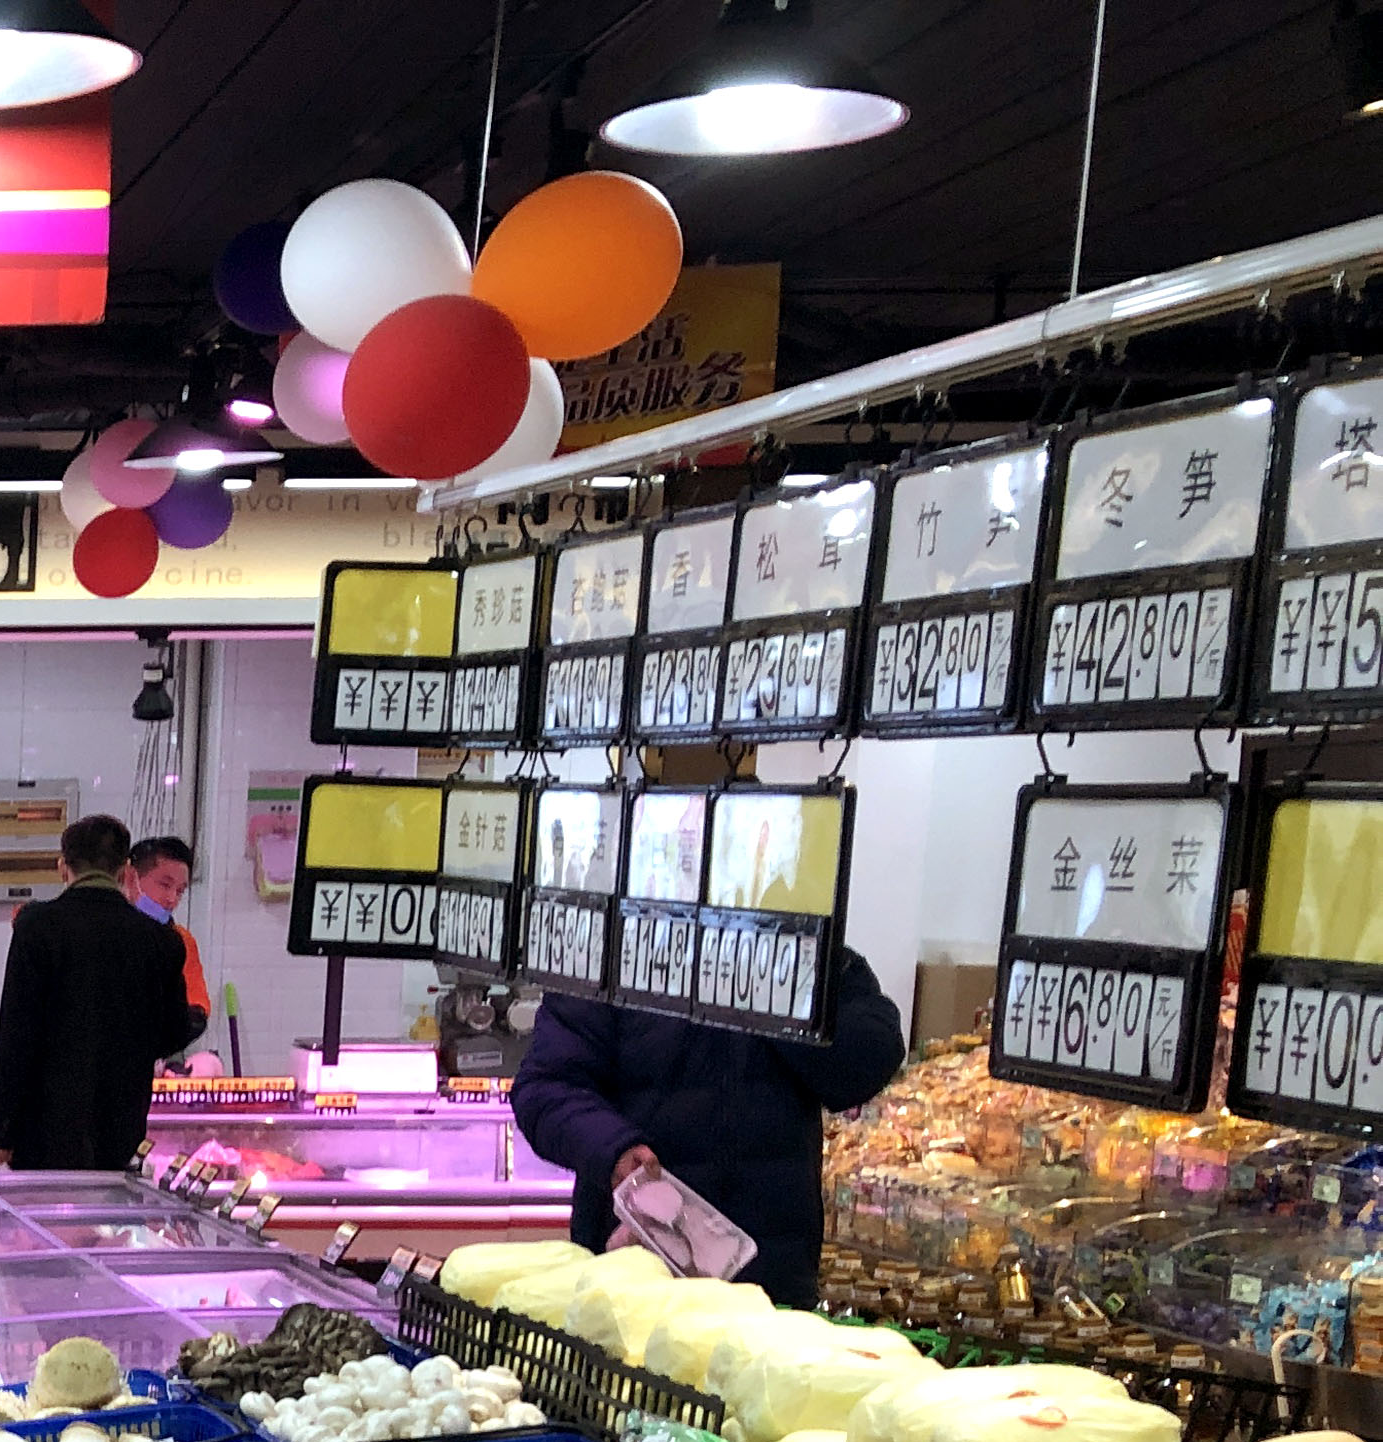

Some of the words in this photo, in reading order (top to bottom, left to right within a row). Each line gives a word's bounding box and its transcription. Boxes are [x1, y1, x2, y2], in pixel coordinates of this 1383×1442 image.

[1101, 449, 1221, 530] 冬笋
[473, 586, 524, 628] 秀珍菇
[458, 810, 507, 852] 金针菇
[1050, 835, 1205, 895] 金丝菜
